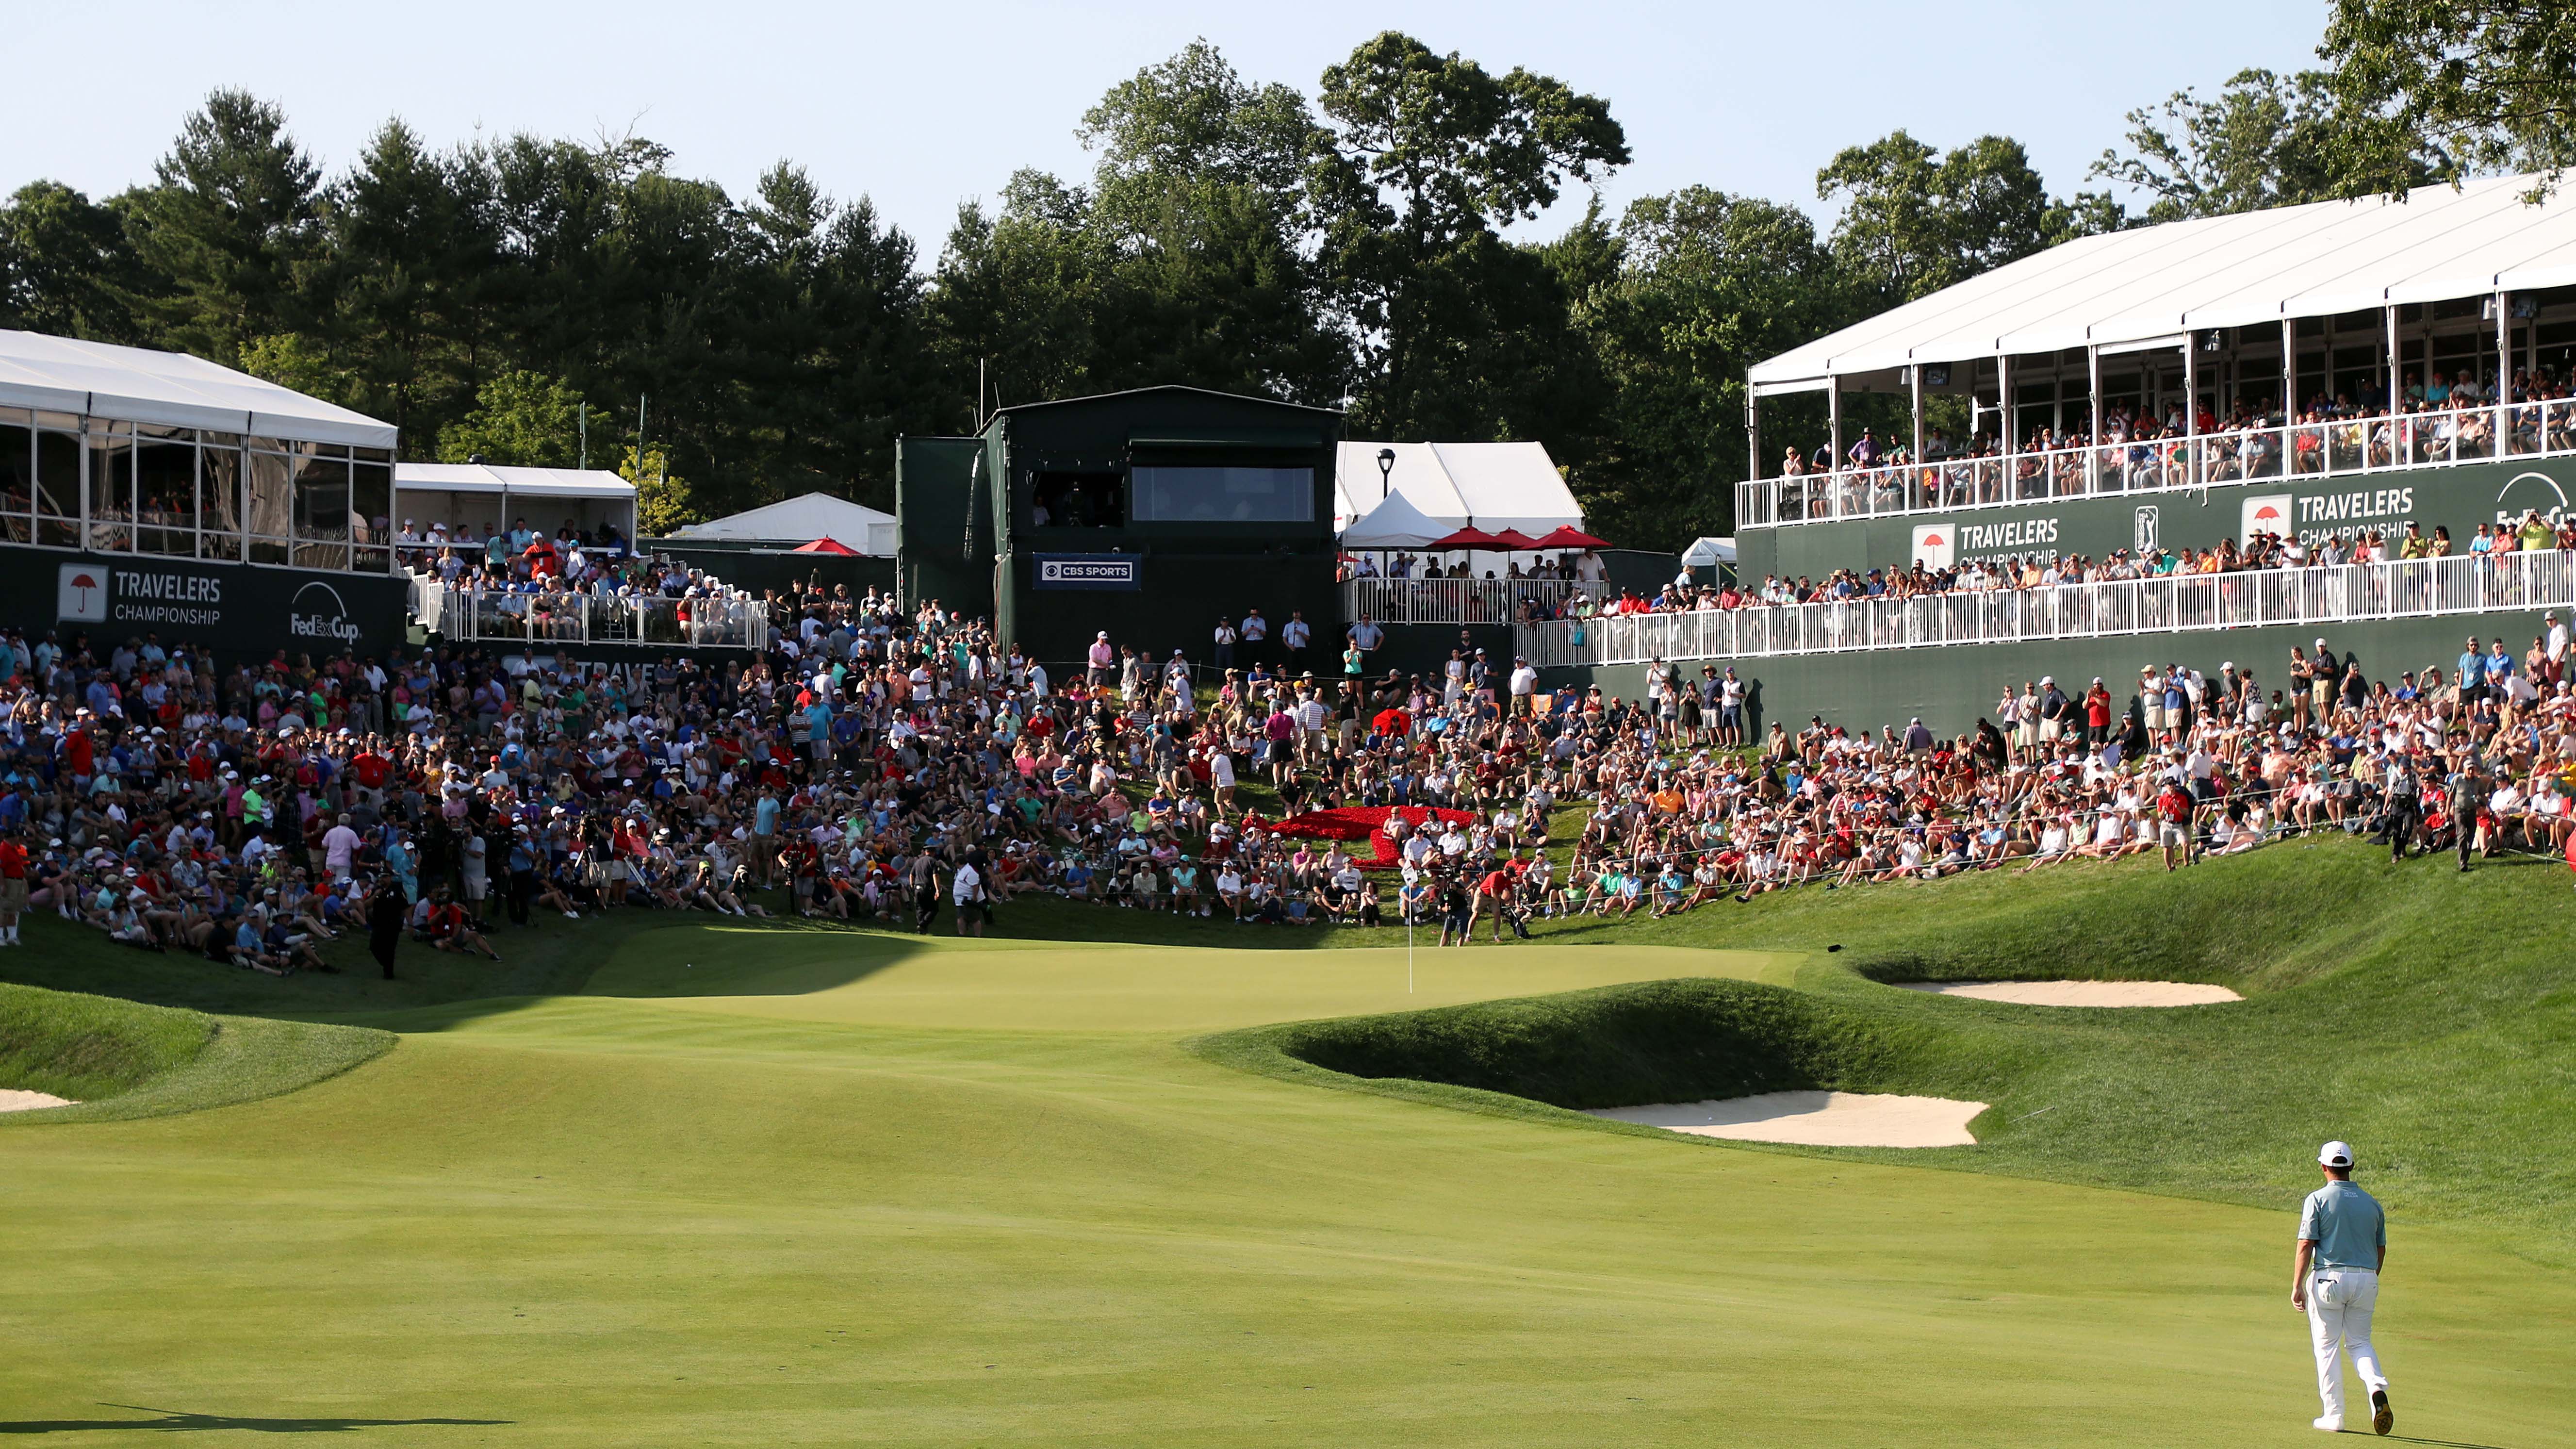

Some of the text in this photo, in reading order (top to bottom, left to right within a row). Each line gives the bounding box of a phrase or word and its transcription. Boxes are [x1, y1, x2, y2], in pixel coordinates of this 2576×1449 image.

[2298, 487, 2413, 522] TRAVELERS
[1960, 518, 2058, 550] TRAVELERS
[115, 571, 220, 603] TRAVELERS
[1063, 567, 1128, 576] CBS SPORTS
[115, 604, 220, 626] CHAMPIONSHIP
[291, 613, 359, 645] FedExCup
